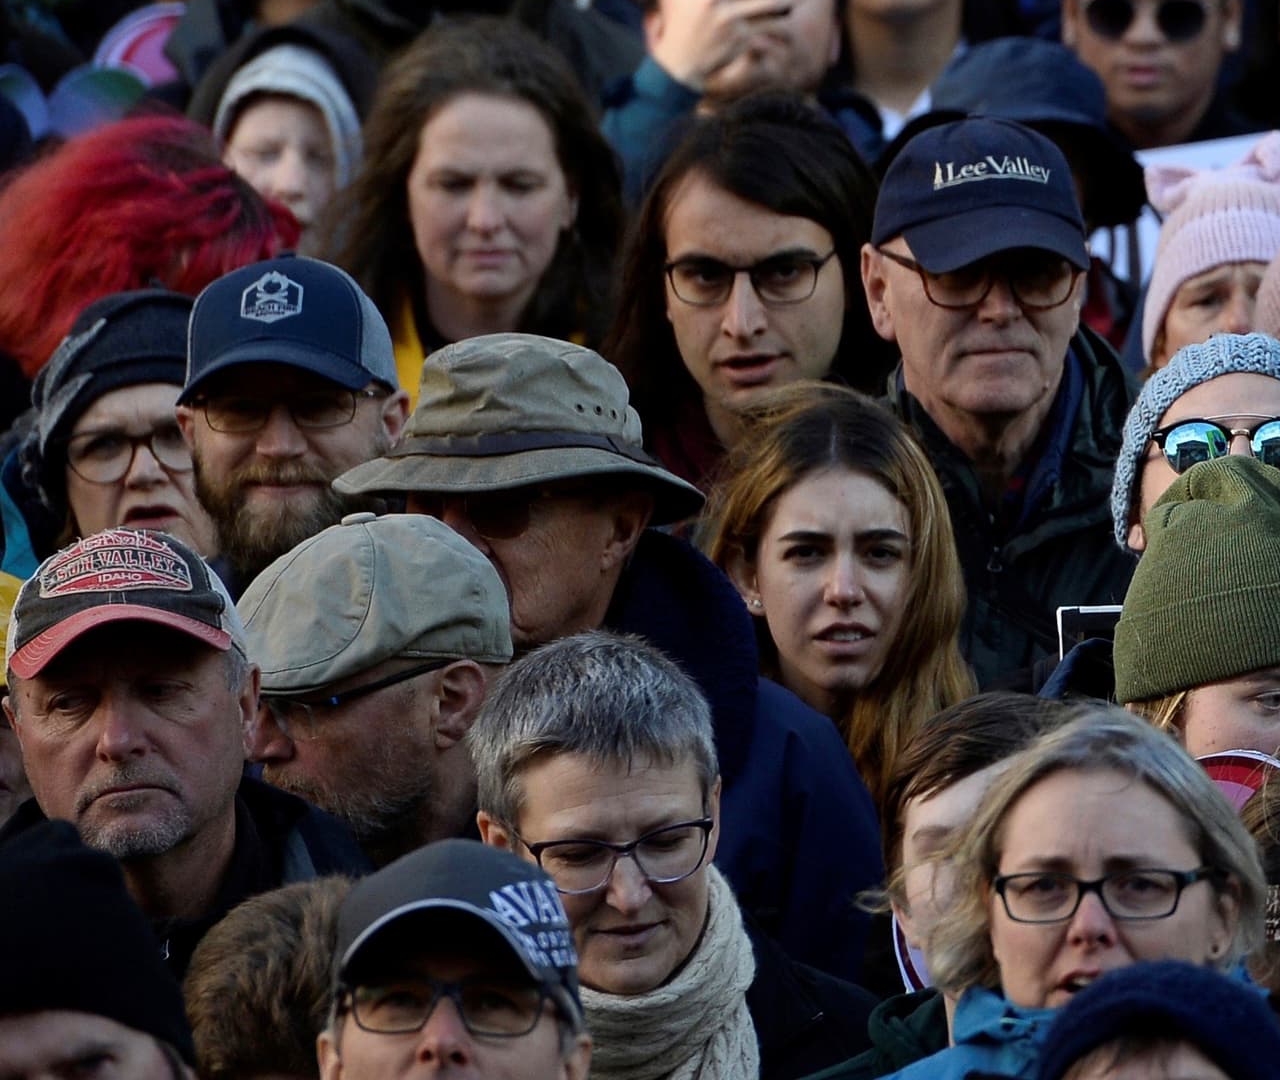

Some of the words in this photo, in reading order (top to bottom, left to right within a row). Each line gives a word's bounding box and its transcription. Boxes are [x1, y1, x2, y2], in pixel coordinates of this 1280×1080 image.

[946, 161, 987, 182] Lee
[985, 155, 1051, 184] Valley
[98, 549, 176, 572] VALLEY
[98, 572, 142, 583] IDAHO
